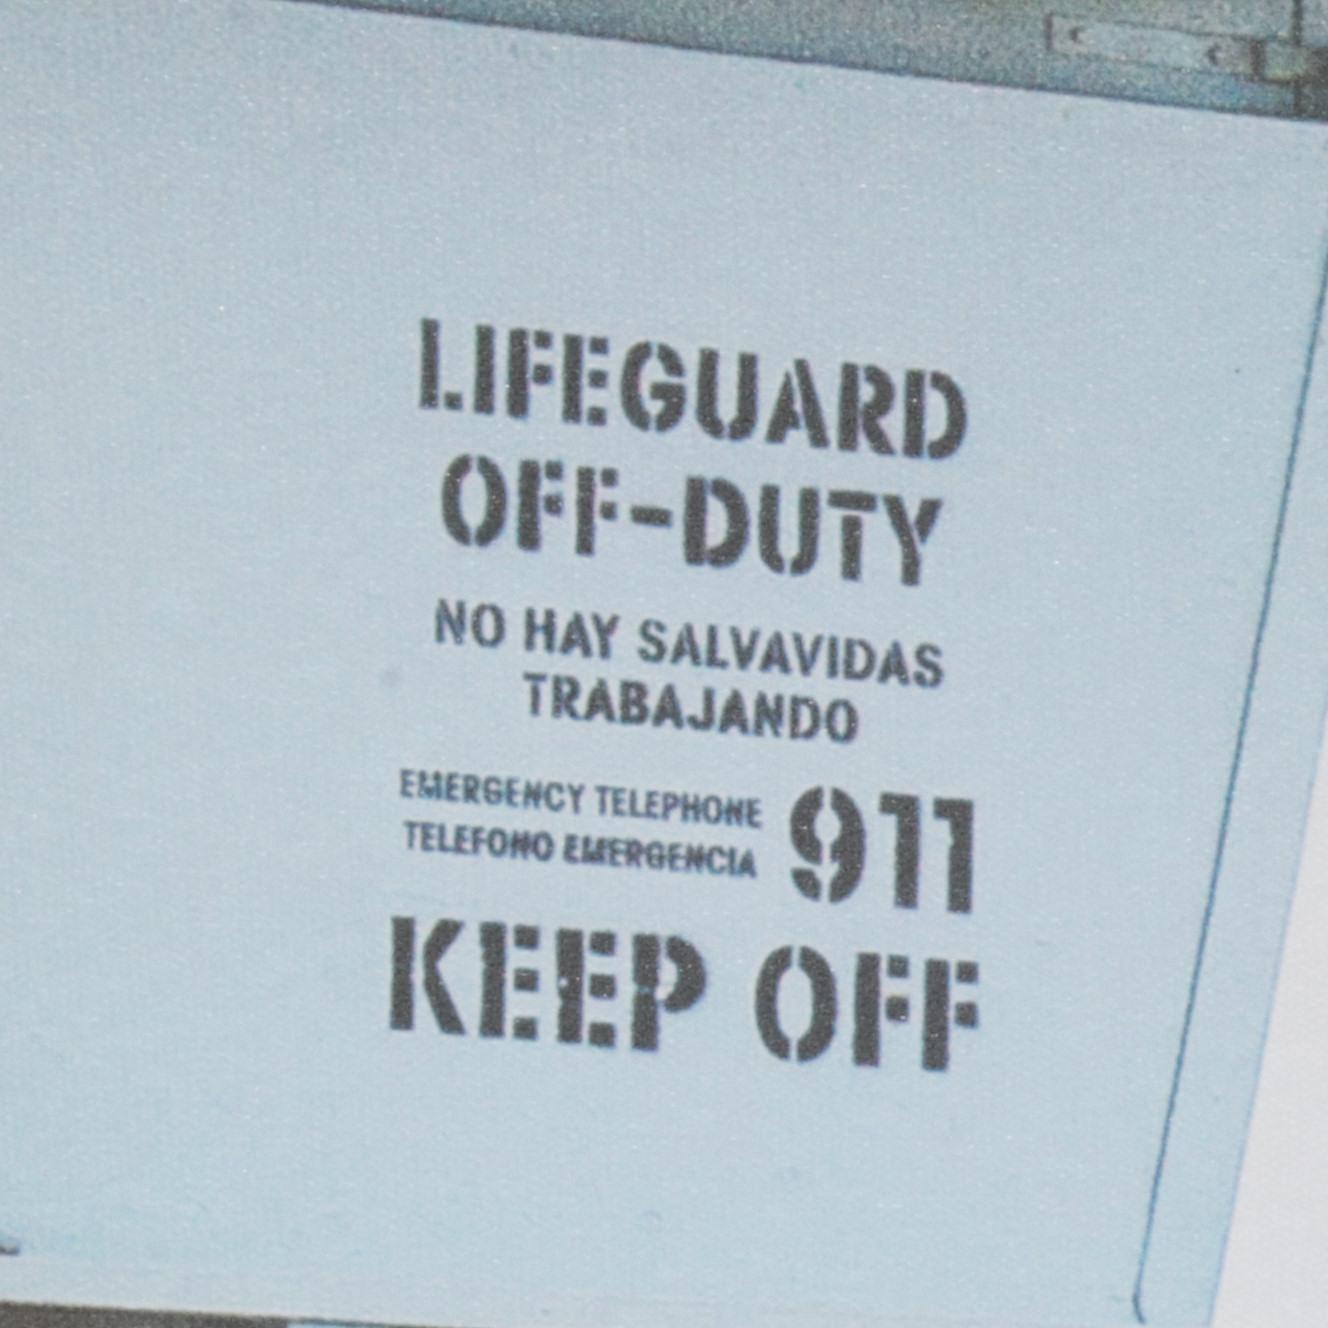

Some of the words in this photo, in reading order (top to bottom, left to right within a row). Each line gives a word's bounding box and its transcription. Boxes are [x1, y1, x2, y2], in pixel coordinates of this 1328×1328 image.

[418, 317, 968, 461] LIFEGUARD
[440, 453, 943, 588] OFF-DUTY
[434, 599, 506, 648] NO
[524, 607, 620, 659] HAY
[638, 618, 944, 690] SALVAVIDAS
[523, 672, 860, 744] TRABAJANDO
[400, 768, 585, 815] EMERGENCY
[595, 784, 764, 829] TELEPHONE
[404, 820, 555, 862] TELEFONO
[562, 833, 758, 879] EMERGENCIA
[789, 785, 975, 914] 911
[389, 916, 708, 1052] KEEP
[755, 944, 981, 1073] OFF
